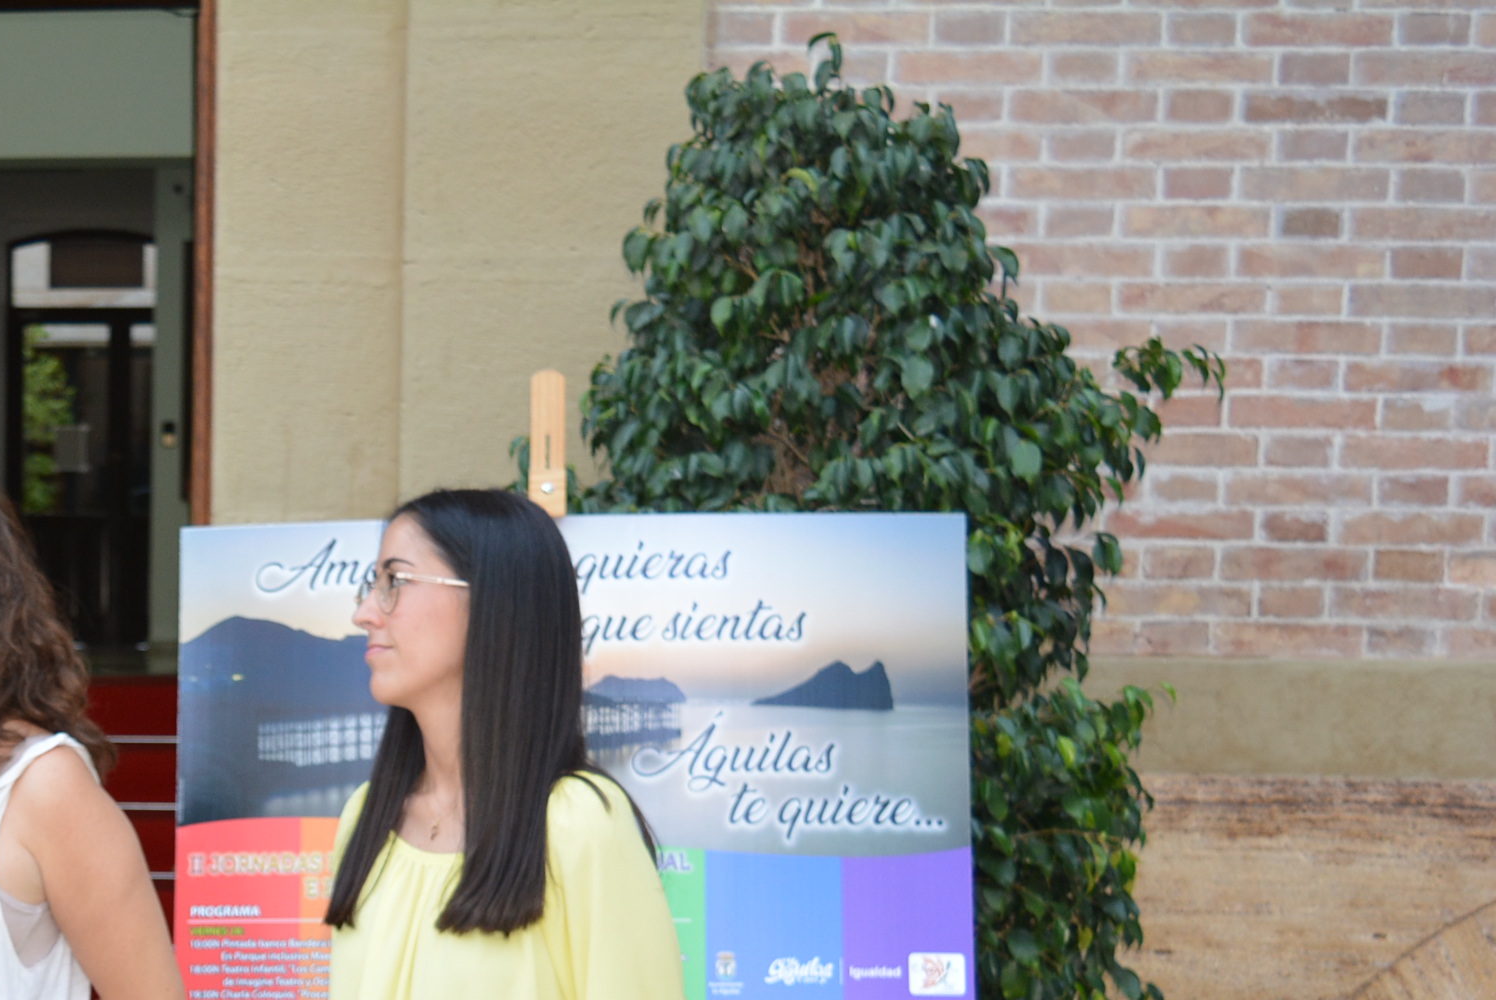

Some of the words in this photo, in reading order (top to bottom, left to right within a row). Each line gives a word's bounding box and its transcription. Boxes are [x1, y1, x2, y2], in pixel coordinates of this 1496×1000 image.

[575, 540, 732, 595] quieras
[661, 599, 806, 642] sientas
[631, 710, 835, 793] Águilas
[728, 783, 766, 825] te
[777, 784, 945, 840] quiere...
[209, 851, 322, 875] JORNADAS
[190, 905, 261, 917] PROGRAMA
[849, 965, 902, 980] Igualdad
